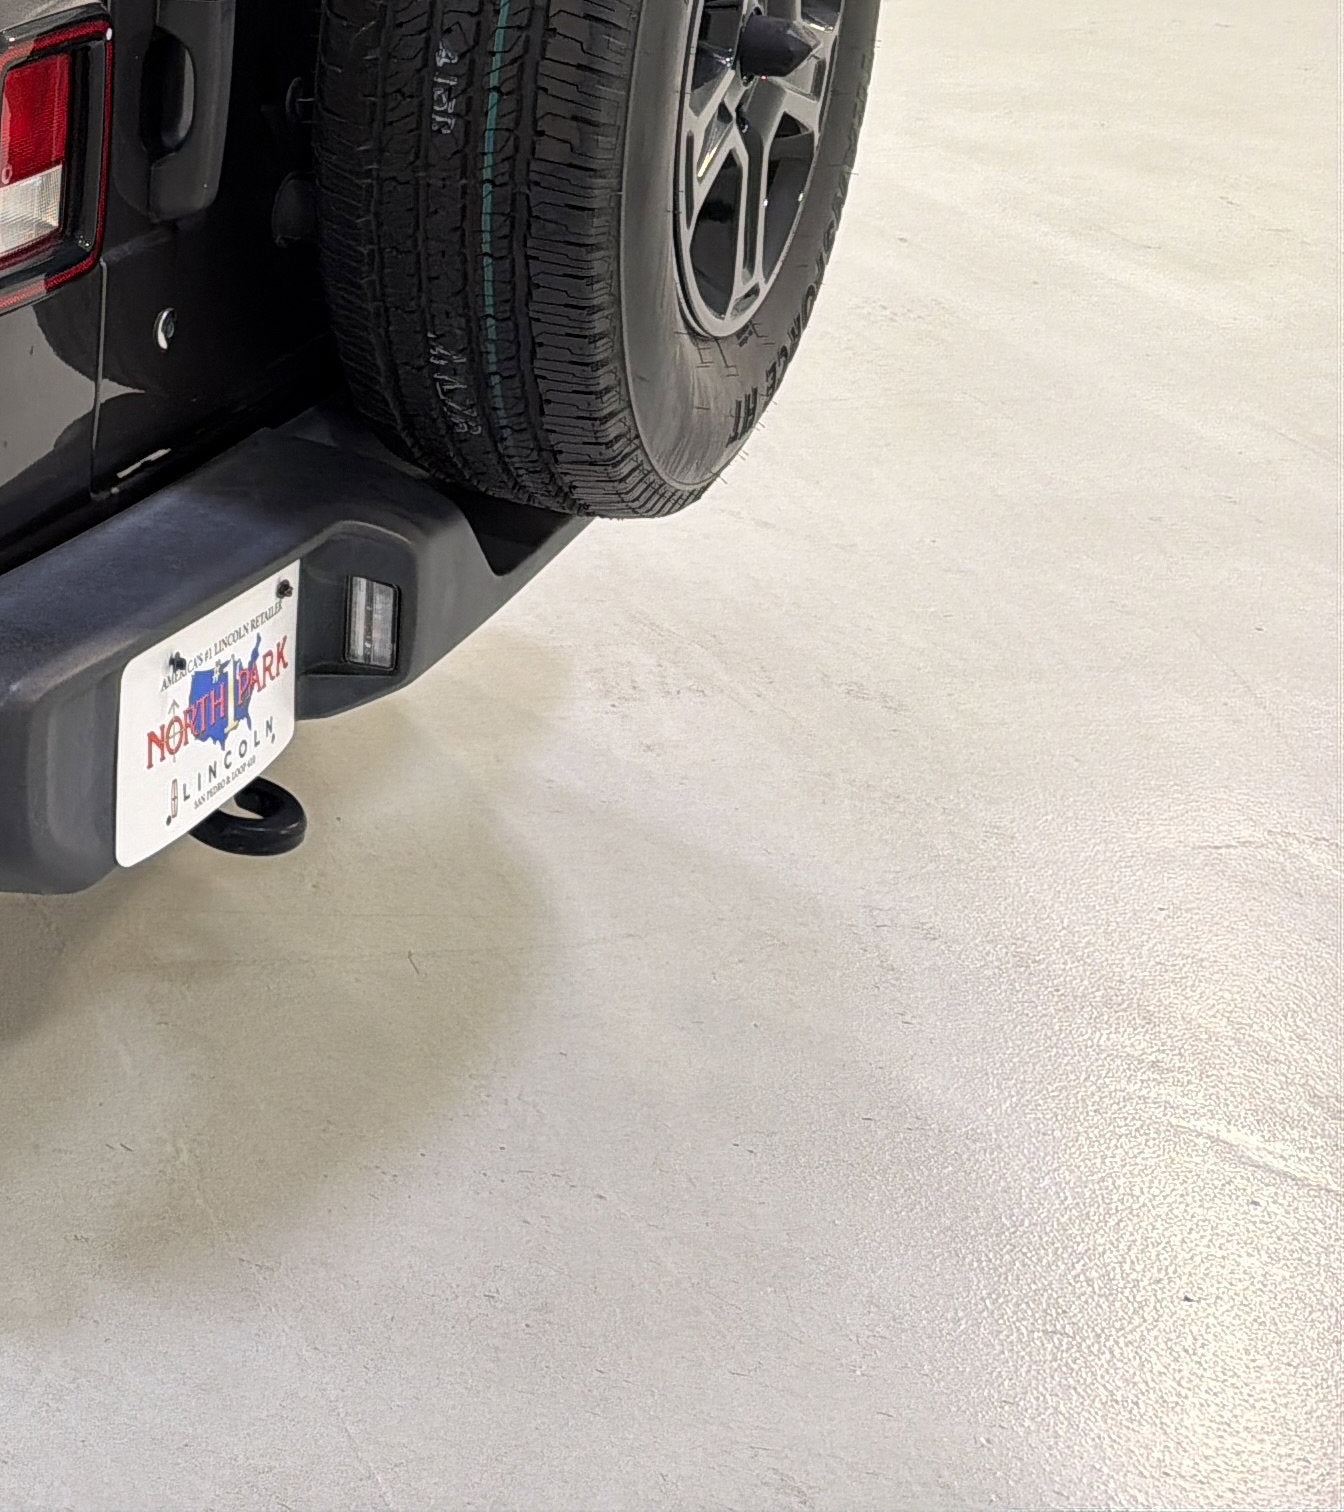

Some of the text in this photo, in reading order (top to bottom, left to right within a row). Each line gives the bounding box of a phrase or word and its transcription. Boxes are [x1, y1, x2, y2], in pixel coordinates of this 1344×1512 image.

[214, 623, 250, 654] LINCOLN
[146, 635, 288, 769] NORTH PARK
[183, 716, 273, 802] LINCOLN
